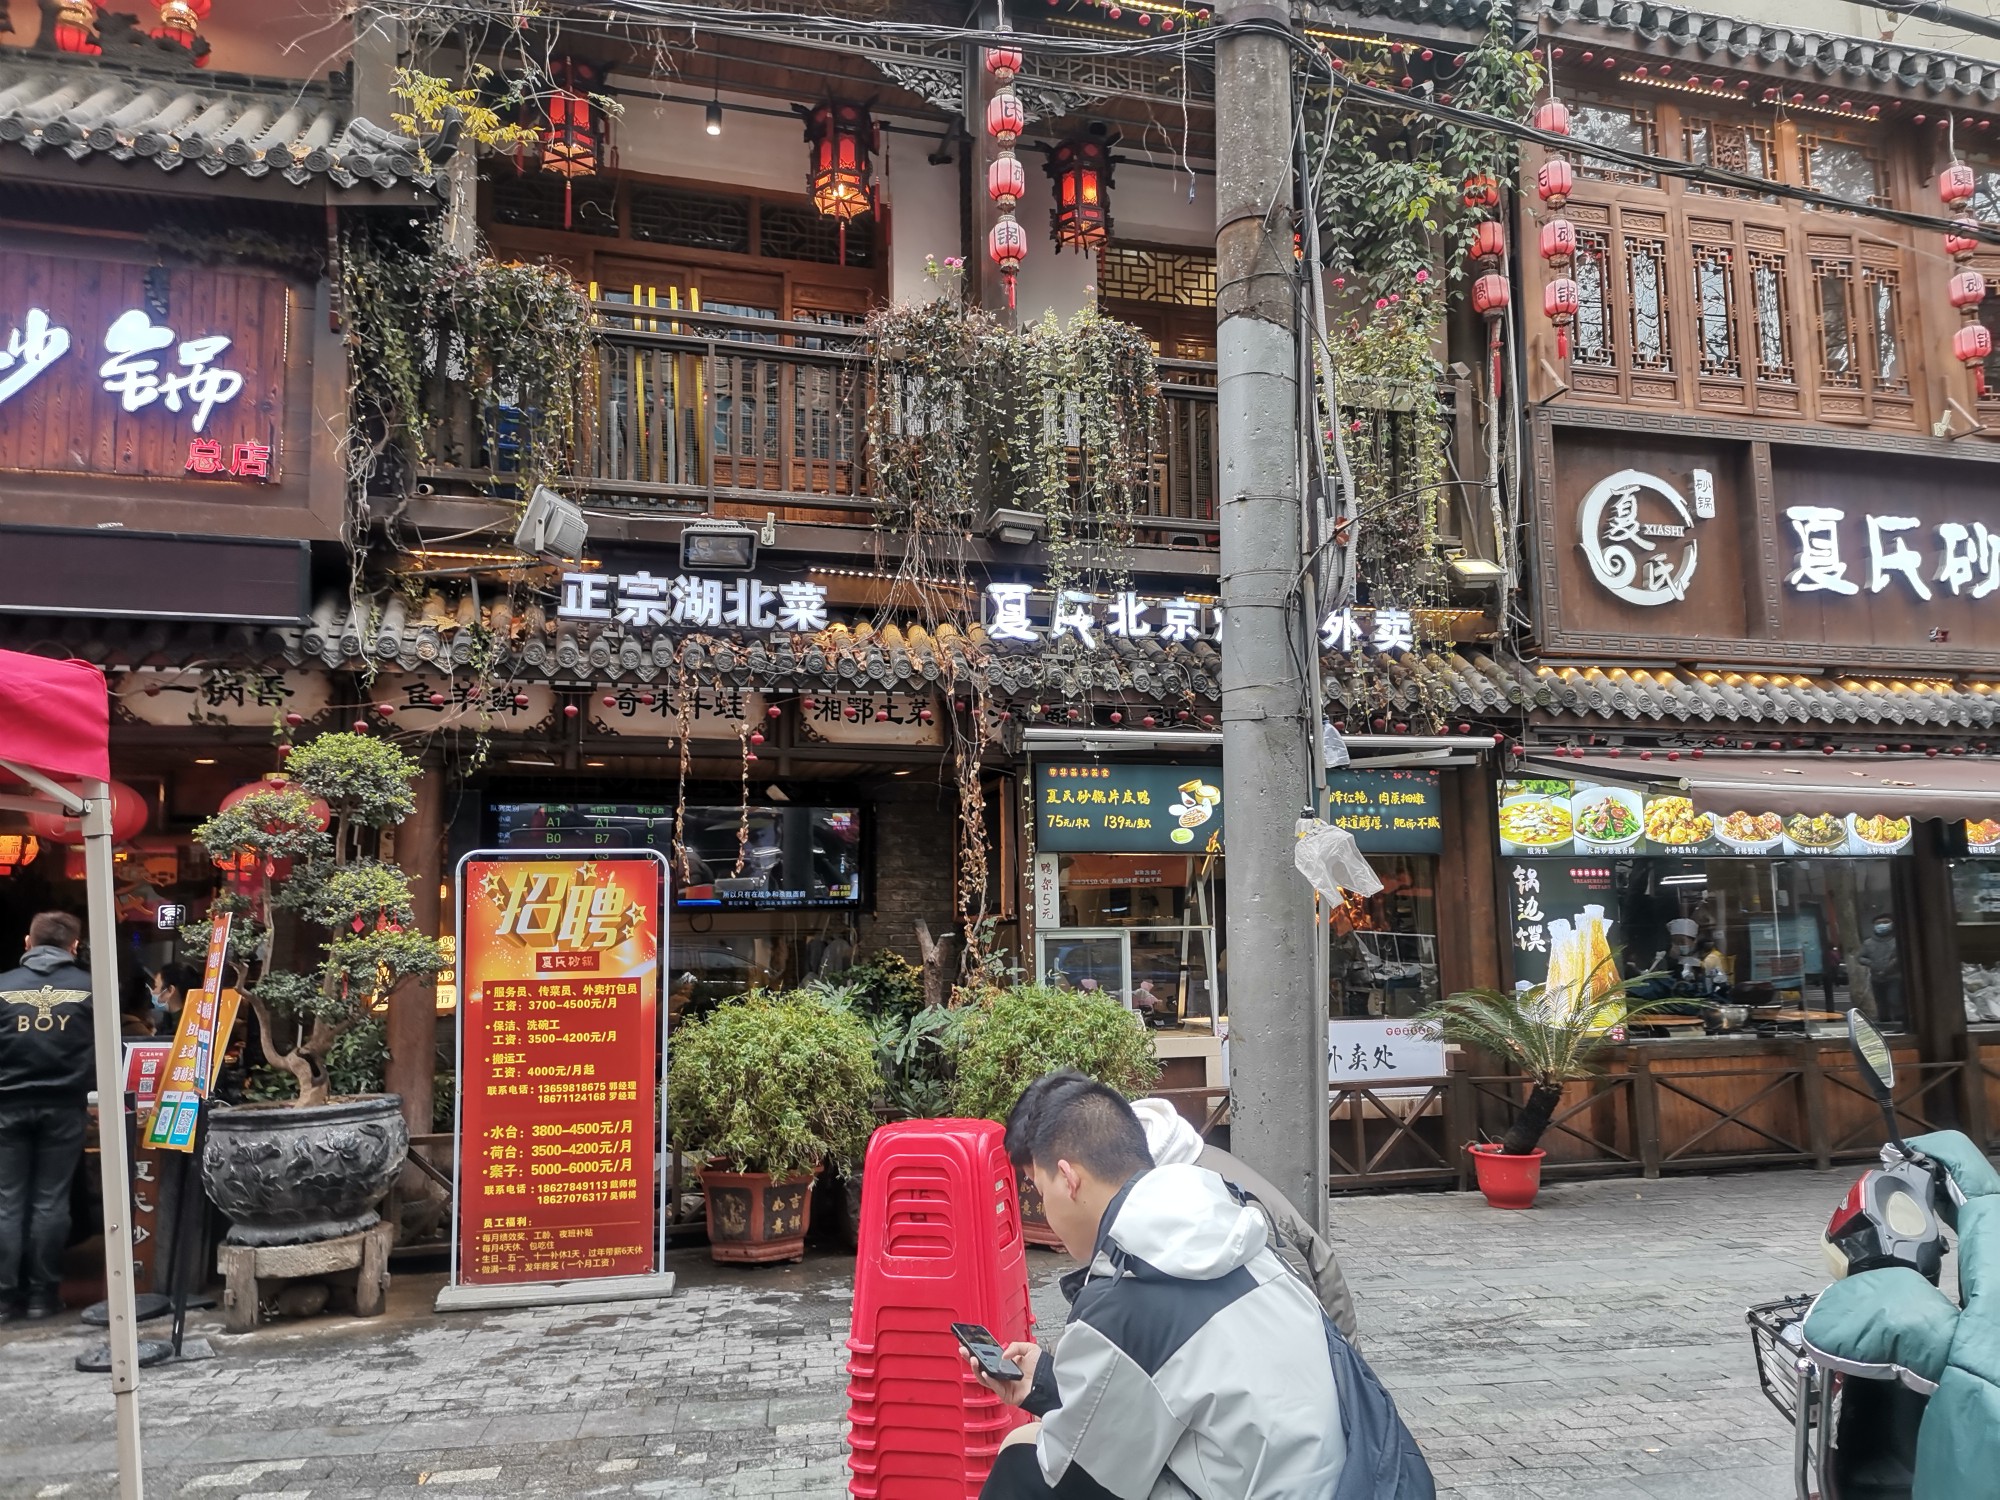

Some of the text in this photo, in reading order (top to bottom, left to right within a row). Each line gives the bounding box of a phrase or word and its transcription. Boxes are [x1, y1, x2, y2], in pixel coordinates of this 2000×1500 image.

[185, 437, 272, 478] 总店
[1695, 479, 1713, 510] 砂锅
[1644, 524, 1685, 537] XIASHI
[557, 570, 830, 632] 正宗湖北菜
[813, 696, 935, 727] 湘鄂土菜
[1046, 788, 1151, 806] 夏氏砂锅片皮鸭
[546, 817, 560, 827] A1
[595, 818, 609, 828] A1
[546, 833, 561, 843] B0
[595, 834, 610, 844] B7
[647, 834, 654, 844] 5
[1040, 862, 1054, 920] 鸭架5元
[495, 871, 626, 948] 招聘
[1512, 864, 1547, 953] 锅边馍
[493, 983, 638, 998] 服务员、传菜员、外卖打包员
[17, 1014, 71, 1032] BOY
[492, 1019, 560, 1031] 保洁、洗碗工
[492, 1053, 526, 1065] 搬运工
[537, 1091, 637, 1104] 18671124168 罗经理
[537, 1192, 607, 1204] 18627076317
